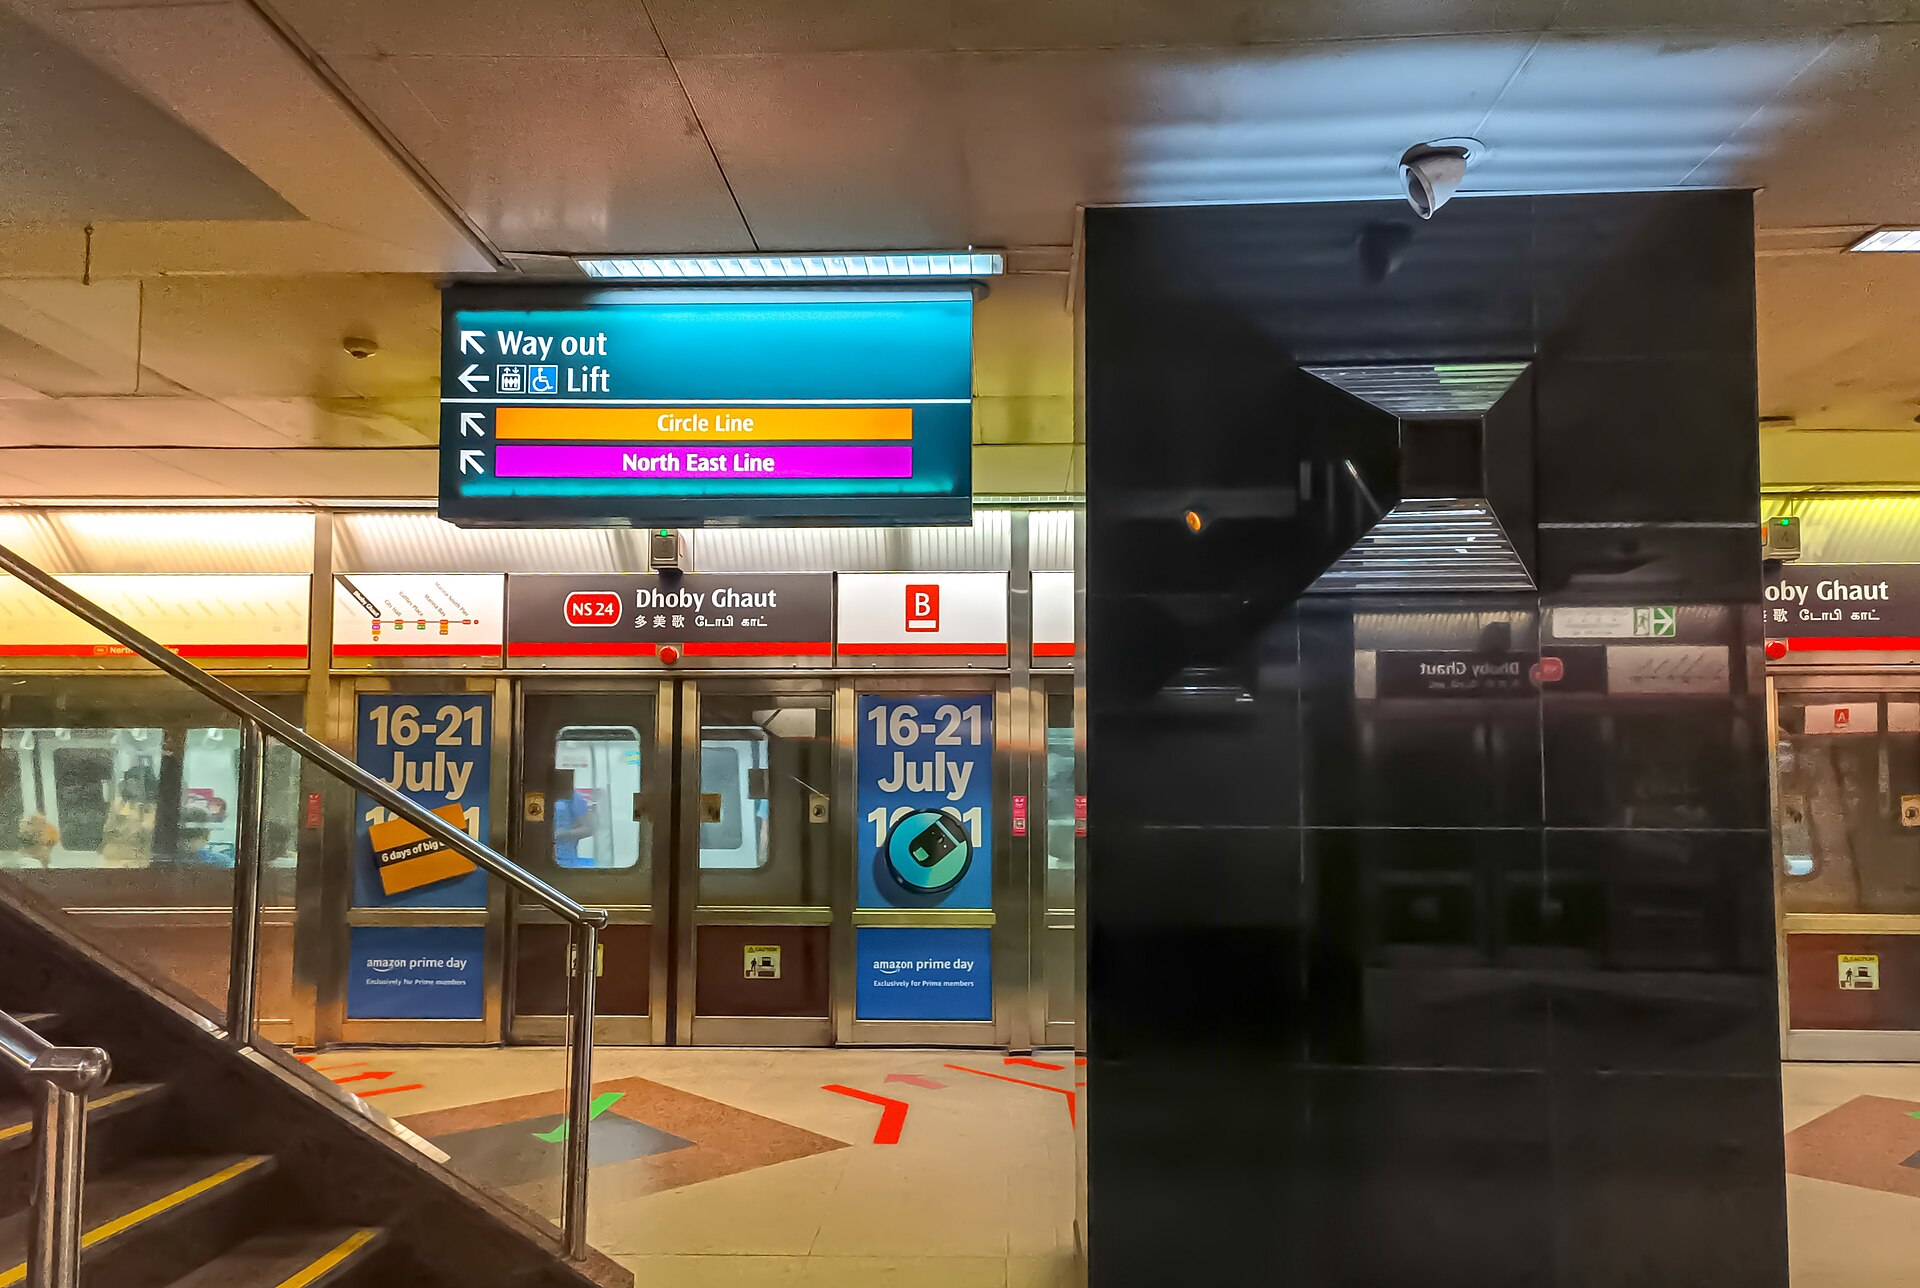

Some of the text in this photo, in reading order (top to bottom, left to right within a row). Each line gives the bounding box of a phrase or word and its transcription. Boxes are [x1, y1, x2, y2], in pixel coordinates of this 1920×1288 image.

[497, 330, 608, 361] Way out
[567, 365, 610, 392] Lift
[657, 413, 754, 432] Circle Line
[622, 452, 775, 472] North East Line
[636, 587, 777, 613] Dhoby Ghaut
[1764, 579, 1889, 606] oby Ghaut
[572, 602, 614, 616] NS 24
[915, 592, 931, 617] B
[1799, 608, 1881, 621] டோபி காட்
[634, 614, 685, 629] 多美歌
[694, 615, 768, 627] டோபி காட்
[369, 704, 483, 746] 16-21
[867, 704, 982, 746] 16-21
[380, 751, 474, 801] July
[877, 751, 974, 801] July
[381, 852, 389, 863] 6
[389, 848, 412, 860] days
[411, 843, 423, 854] of
[422, 840, 439, 851] big
[366, 956, 467, 970] amazon prime day
[873, 958, 974, 972] amazon prime day
[873, 980, 909, 988] Exclusively
